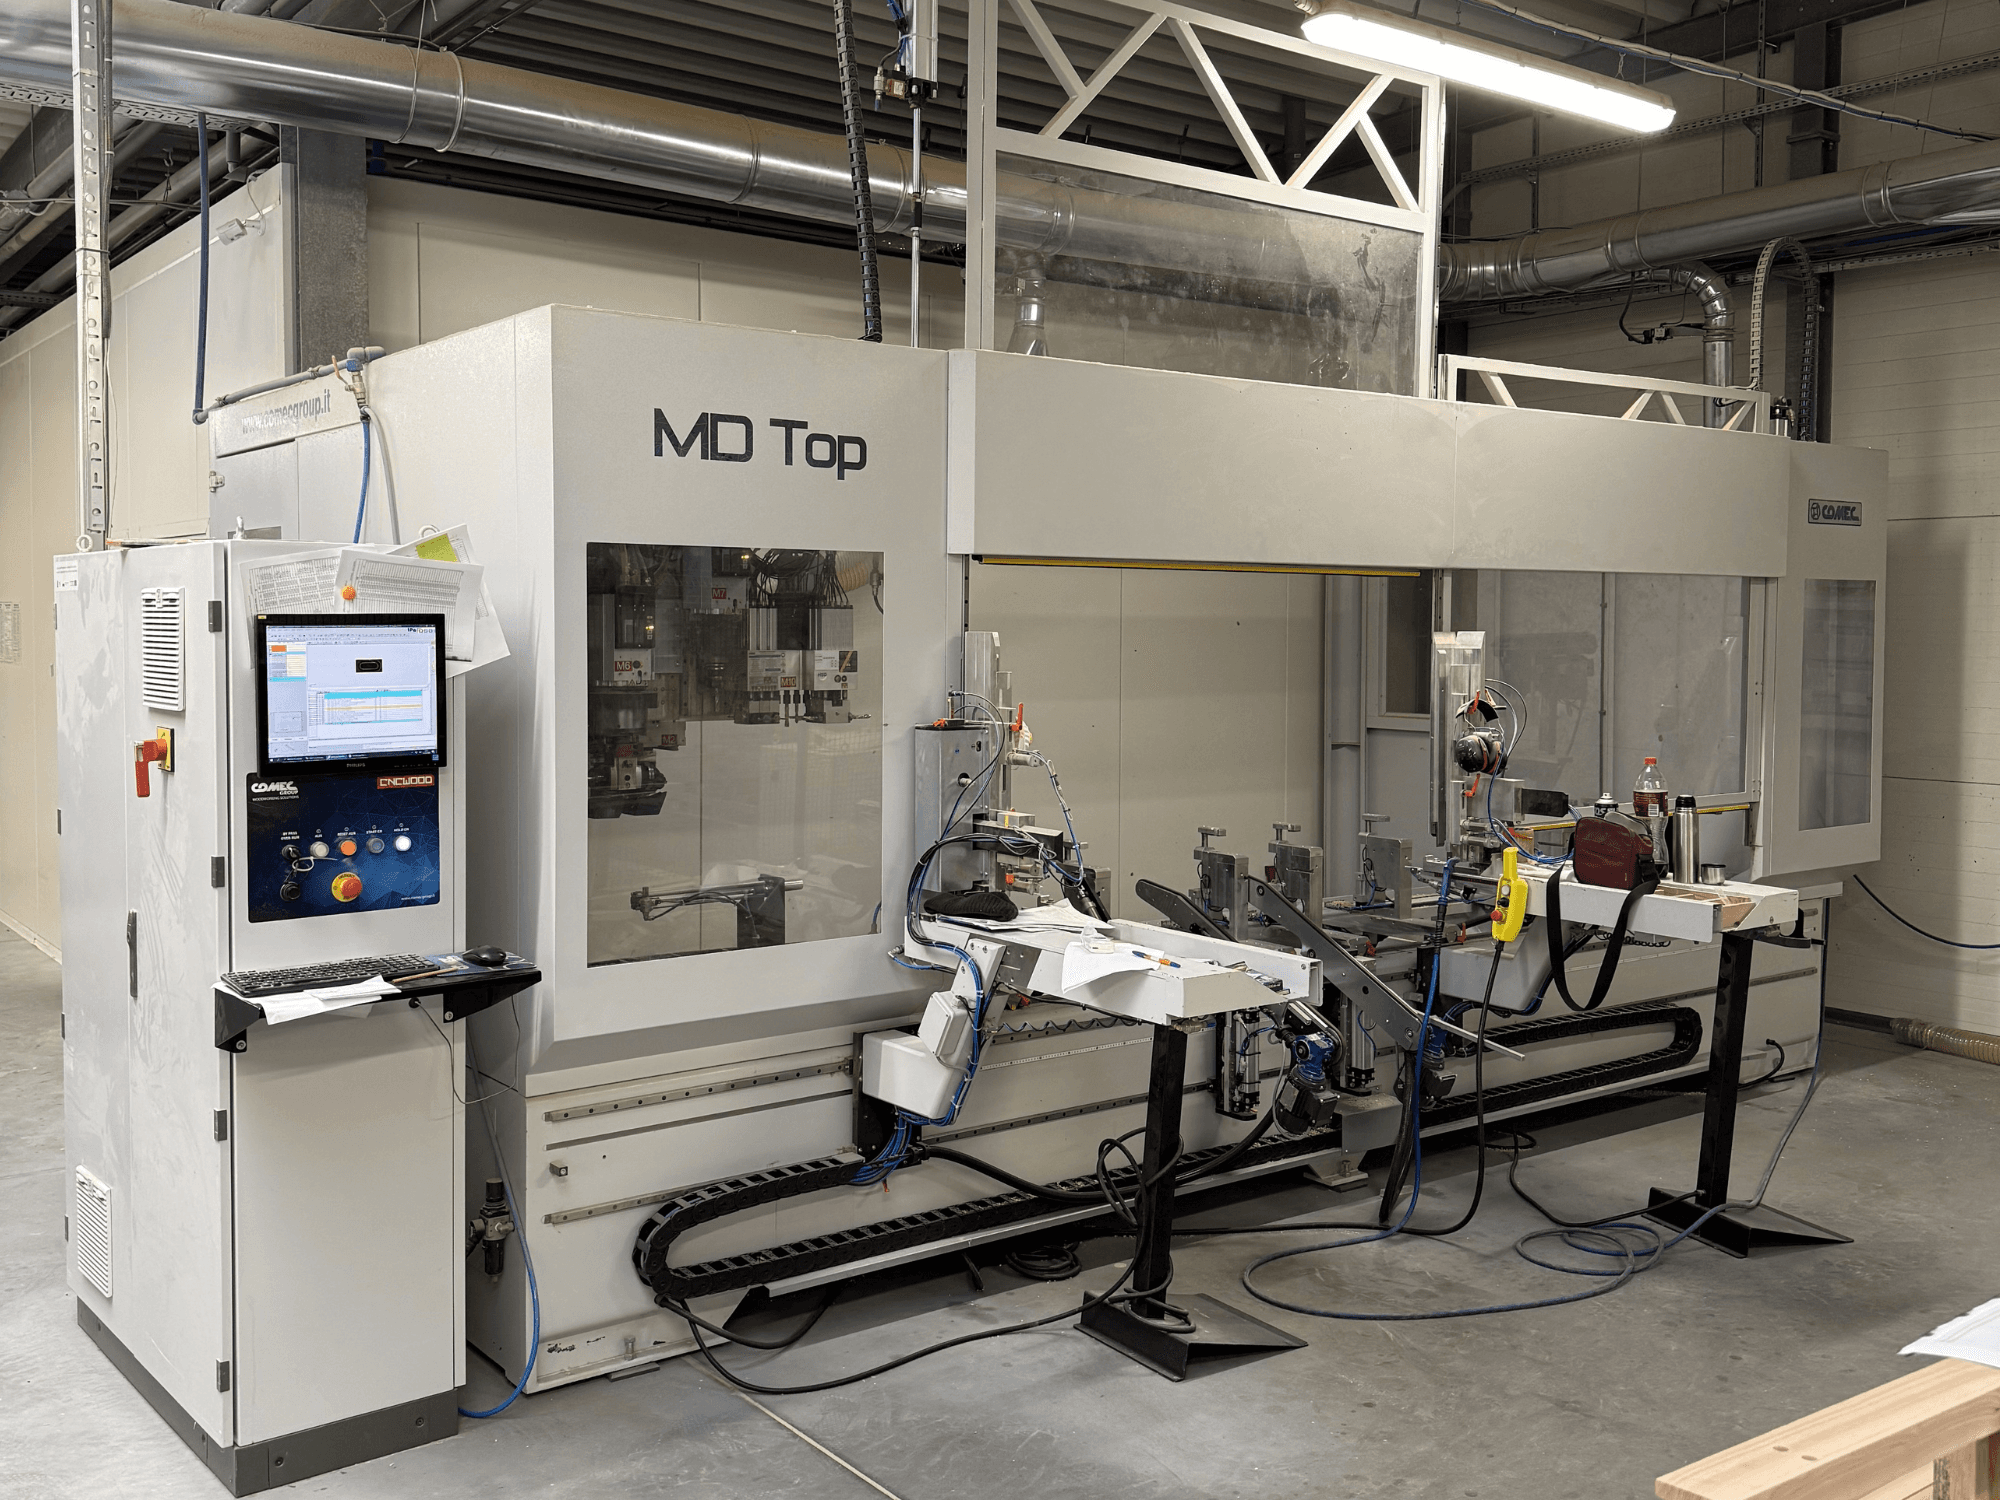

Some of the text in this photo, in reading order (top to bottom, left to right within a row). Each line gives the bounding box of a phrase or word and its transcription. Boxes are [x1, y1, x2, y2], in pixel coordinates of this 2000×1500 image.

[654, 408, 867, 480] MD Top
[1822, 505, 1860, 521] COMEC
[712, 588, 726, 600] M7
[616, 661, 631, 671] M6
[781, 677, 796, 687] M10
[662, 735, 676, 745] M2
[251, 781, 299, 793] COMEC
[379, 775, 433, 787] CNCWOOD
